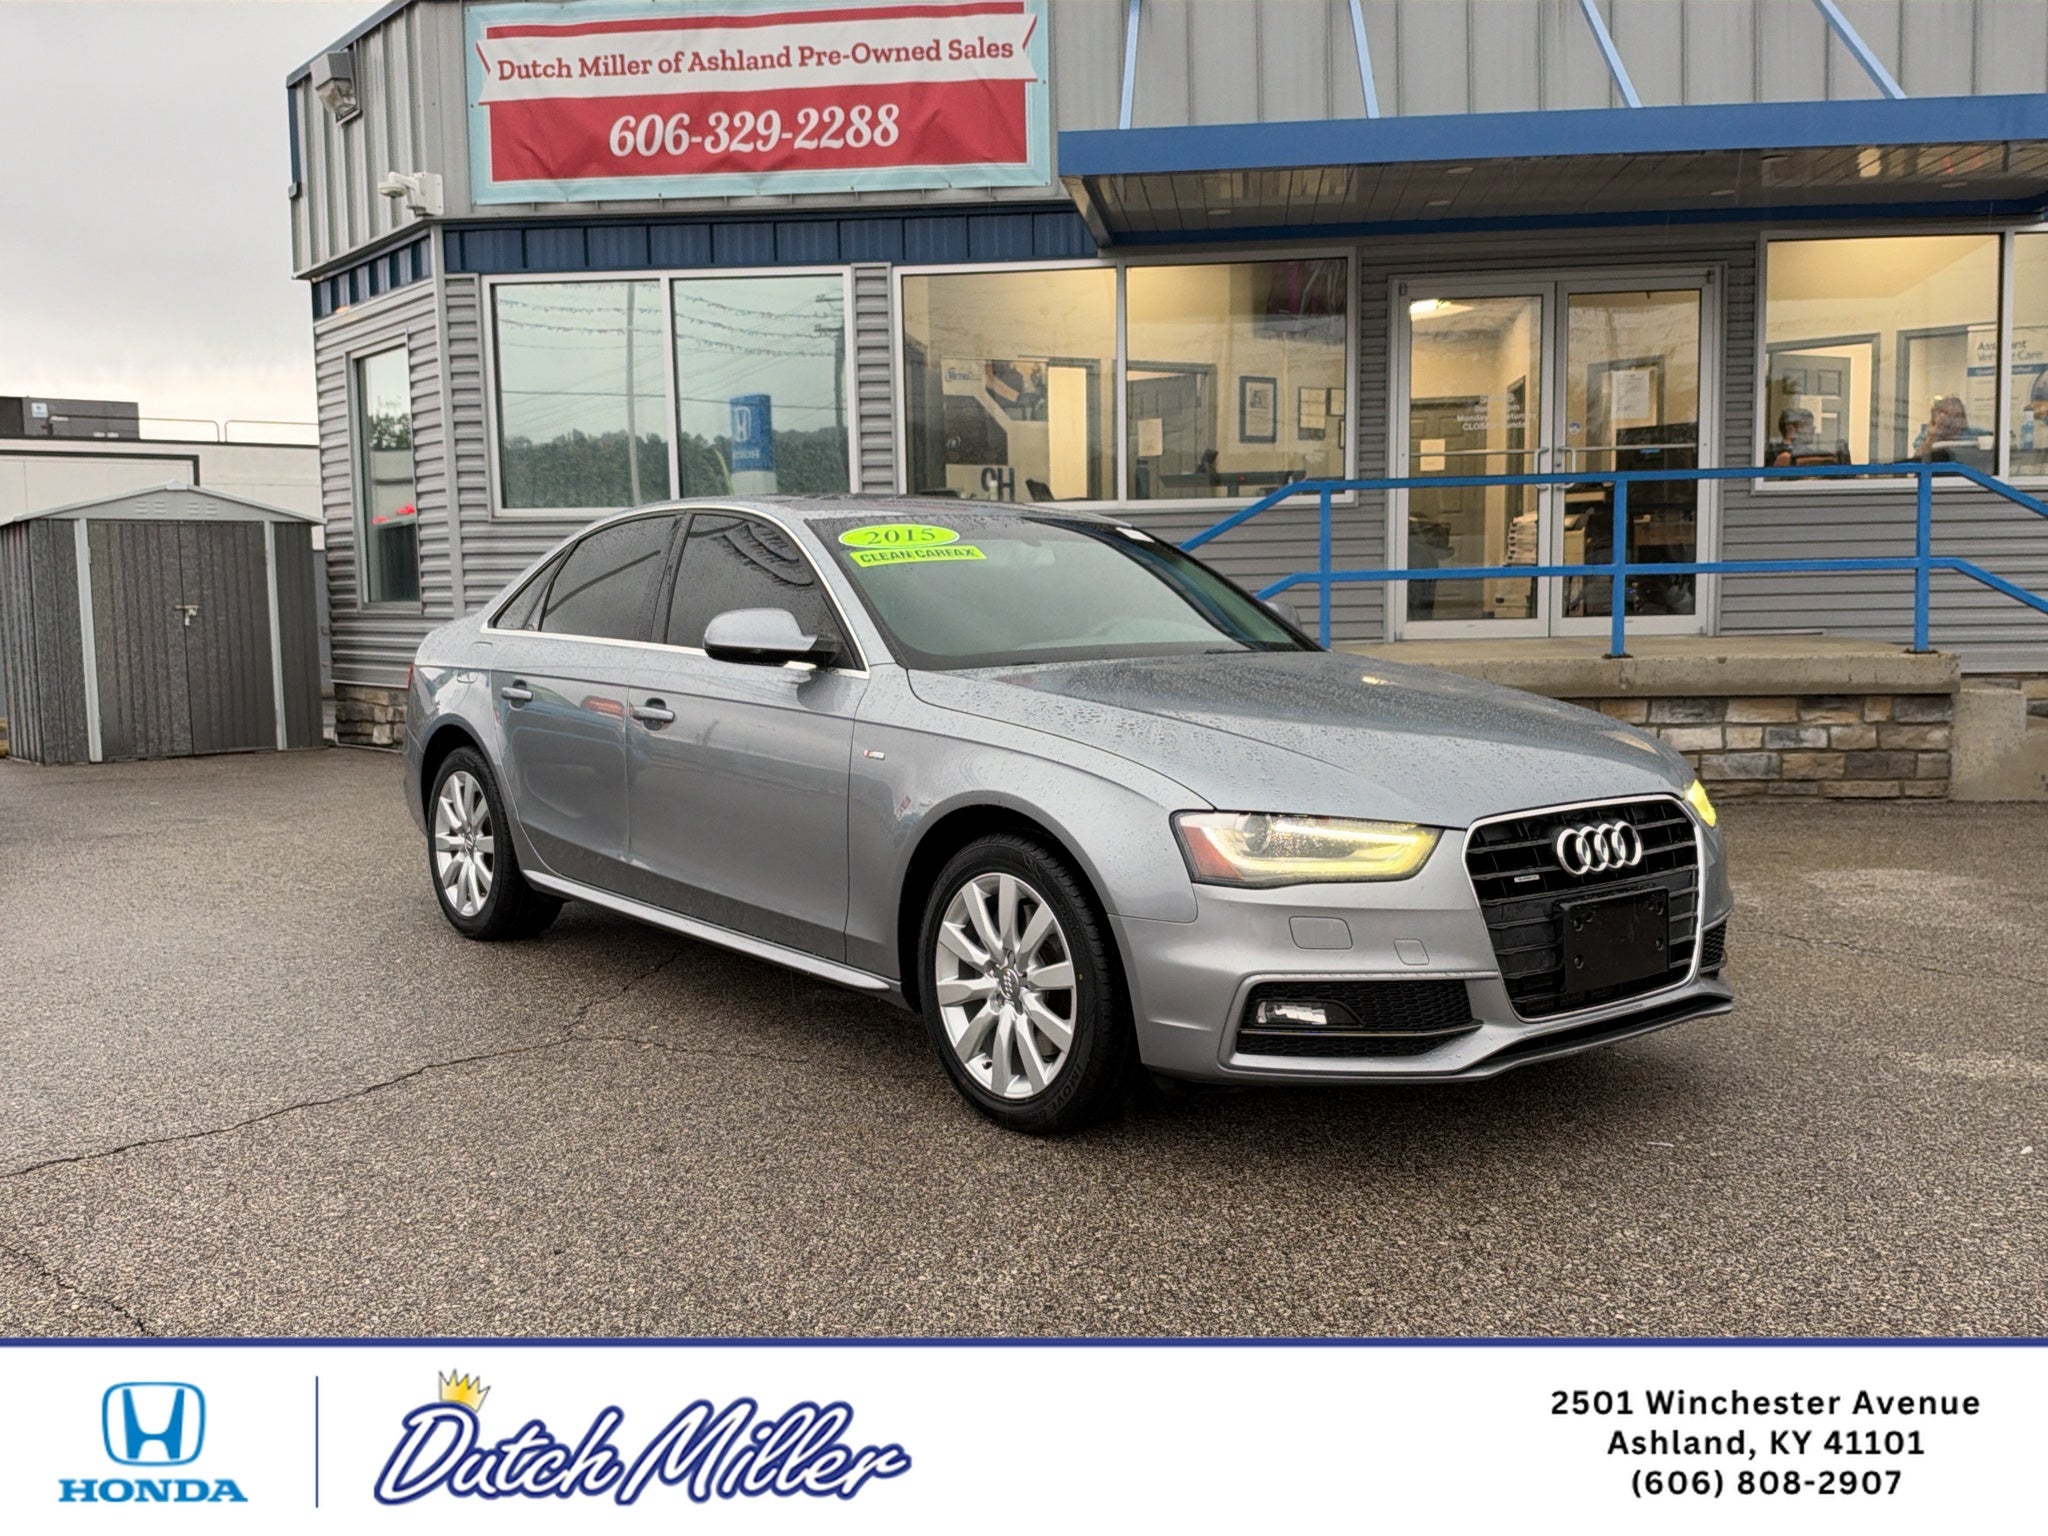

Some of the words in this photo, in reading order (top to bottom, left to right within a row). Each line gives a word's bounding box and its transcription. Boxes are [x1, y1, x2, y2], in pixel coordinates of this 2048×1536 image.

[498, 58, 571, 80] Dutch
[579, 55, 651, 78] Miller
[657, 51, 684, 73] of
[688, 46, 791, 72] Ashland
[798, 40, 941, 67] Pre-Owned
[948, 37, 1012, 60] Sales
[609, 103, 899, 157] 606-329-2288
[1977, 339, 2027, 351] Assant
[864, 527, 937, 545] 2015
[859, 550, 911, 563] CLEAN
[915, 548, 975, 559] CARFAX
